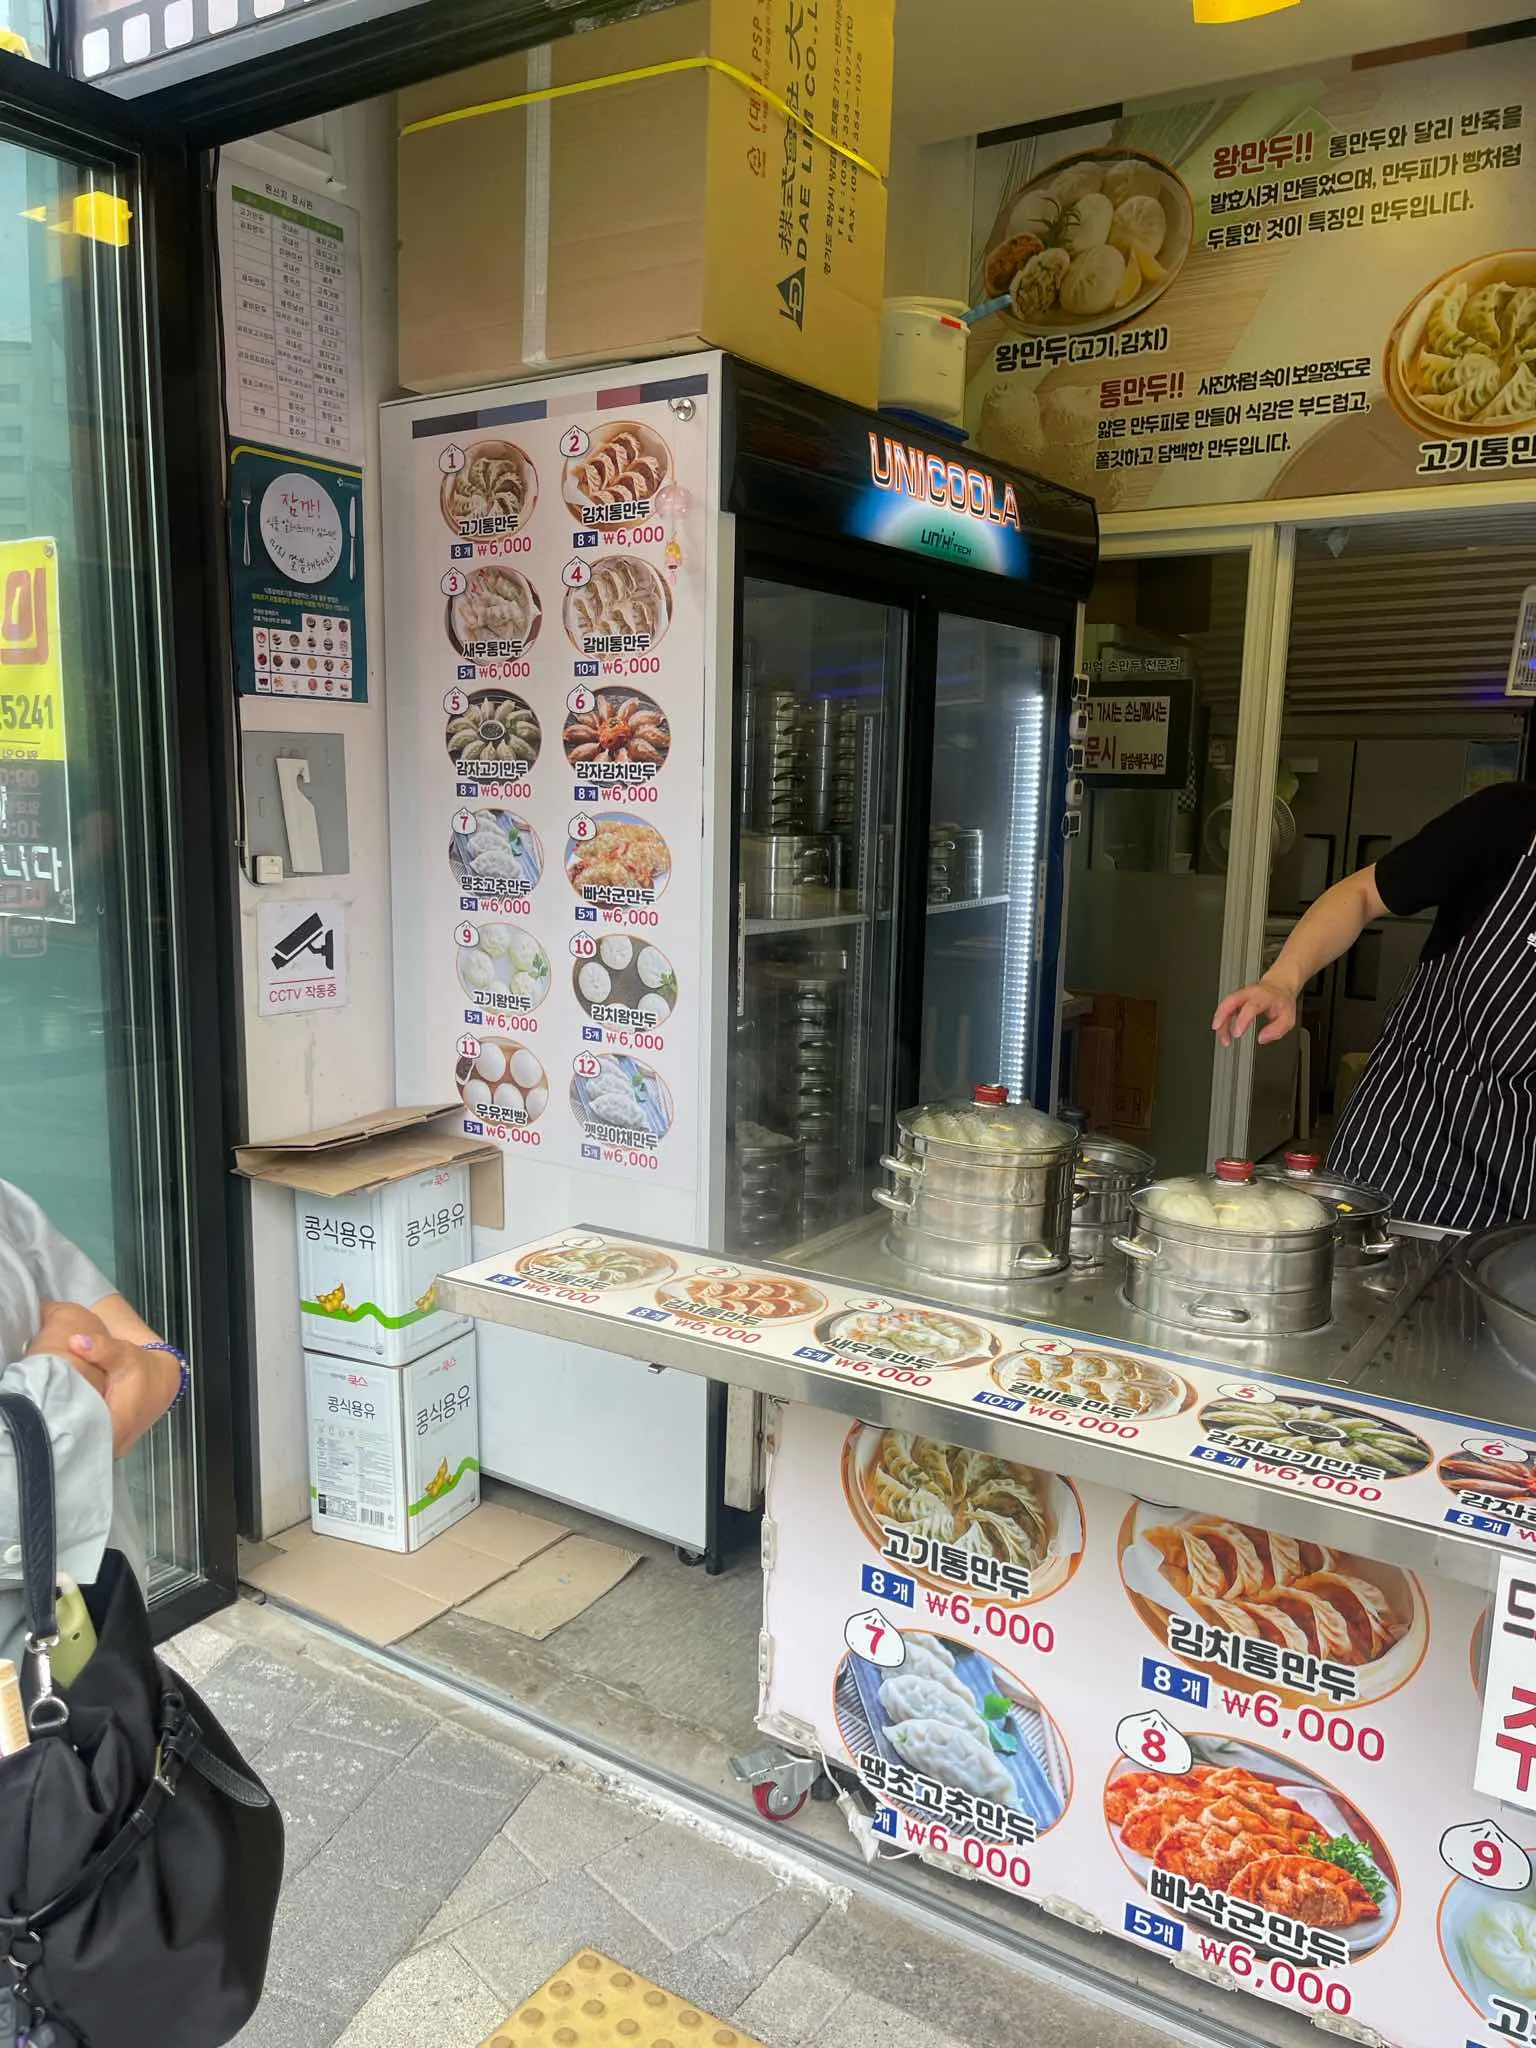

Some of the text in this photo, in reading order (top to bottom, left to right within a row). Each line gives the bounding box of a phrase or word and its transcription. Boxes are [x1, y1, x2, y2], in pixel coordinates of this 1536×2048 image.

[1213, 105, 1522, 180] 왕만두!! 통만두와 달리 반죽을
[1210, 143, 1522, 214] 발효시켜 만들었으며, 만두피가 빵처럼
[796, 187, 810, 261] DAE
[1207, 190, 1474, 250] 두툼한 것이 특징인 만두입니다.
[995, 326, 1168, 373] 왕만두(고기,김치)
[1100, 372, 1184, 409] 통만두!!
[1198, 371, 1257, 397] 사진처럼
[1259, 367, 1290, 390] 속이
[1130, 411, 1190, 437] 만두피로
[1194, 406, 1241, 430] 만들어
[1245, 398, 1294, 423] 식감은
[1298, 391, 1372, 419] 부드럽고,
[570, 435, 580, 452] 2
[1157, 440, 1204, 464] 담백한
[1207, 431, 1292, 459] 만두입니다.
[447, 453, 457, 469] 1
[867, 431, 1021, 531] UNICOOLA
[582, 503, 650, 523] 김치통만두
[458, 516, 519, 535] 고기통만두
[477, 537, 532, 555] ₩6,000
[603, 526, 665, 547] ₩6,000
[449, 576, 458, 591] 3
[571, 567, 582, 582] 4
[463, 641, 523, 657] 새우통만두
[583, 635, 650, 653] 갈비통만두
[479, 662, 530, 679] ₩6,000
[602, 657, 660, 675] ₩6,000
[1108, 659, 1140, 672] 손만두
[452, 696, 460, 711] 5
[576, 694, 585, 710] 6
[456, 762, 528, 777] 감자고기만두
[576, 763, 656, 780] 감자김치만두
[480, 784, 532, 798] ₩6,000
[601, 787, 658, 802] ₩6,000
[460, 816, 468, 830] 7
[578, 822, 587, 836] 8
[461, 876, 531, 894] 땡초고추만두
[480, 898, 531, 914] ₩6,000
[583, 887, 655, 905] 빠삭군만두
[602, 910, 658, 926] ₩6,000
[462, 929, 471, 944] 9
[574, 940, 594, 956] 10
[269, 984, 337, 1003] CCTV 작동중
[473, 991, 531, 1010] 고기왕만두
[486, 1015, 538, 1032] ₩6,000
[592, 1006, 657, 1027] 김치왕만두
[462, 1040, 477, 1056] 11
[606, 1033, 664, 1051] ₩6,000
[578, 1058, 596, 1075] 12
[476, 1104, 527, 1124] 우유찐빵
[486, 1126, 541, 1146] ₩6,000
[603, 1150, 658, 1170] ₩6,000
[304, 1215, 377, 1250] 콩식용유
[406, 1202, 465, 1248] 콩식용유
[575, 1239, 588, 1247] 1
[523, 1267, 610, 1290] 고기통만두
[711, 1266, 728, 1277] 2
[523, 1279, 600, 1304] ₩6,000
[664, 1299, 764, 1327] 김치통만두
[859, 1300, 880, 1311] 3
[675, 1317, 761, 1344] ₩6,000
[824, 1337, 937, 1370] 새우통만두
[1035, 1342, 1058, 1353] 4
[800, 1349, 932, 1387] 5개 ₩6,000
[1008, 1382, 1136, 1420] 갈비통만두
[1238, 1385, 1257, 1398] 5
[327, 1395, 375, 1420] 콩식용유
[416, 1384, 471, 1435] 콩식용유
[981, 1392, 1140, 1440] 10개 ₩6,000
[1207, 1430, 1385, 1480] 감자고기만두
[1482, 1442, 1504, 1456] 6
[1253, 1461, 1382, 1503] ₩6,000
[1461, 1491, 1536, 1522] 감자
[883, 1527, 1032, 1598] 고기통만두
[926, 1591, 1055, 1654] ₩6,000
[865, 1625, 885, 1656] 7
[1168, 1617, 1357, 1701] 김치통만두
[1223, 1688, 1386, 1762] ₩6,000
[1141, 1728, 1167, 1763] 8
[859, 1754, 1036, 1845] 땡초고추만두
[1472, 1840, 1502, 1876] 9
[1151, 1869, 1350, 1967] 빠삭군만두
[1132, 1911, 1352, 2016] 5개 ₩6,000
